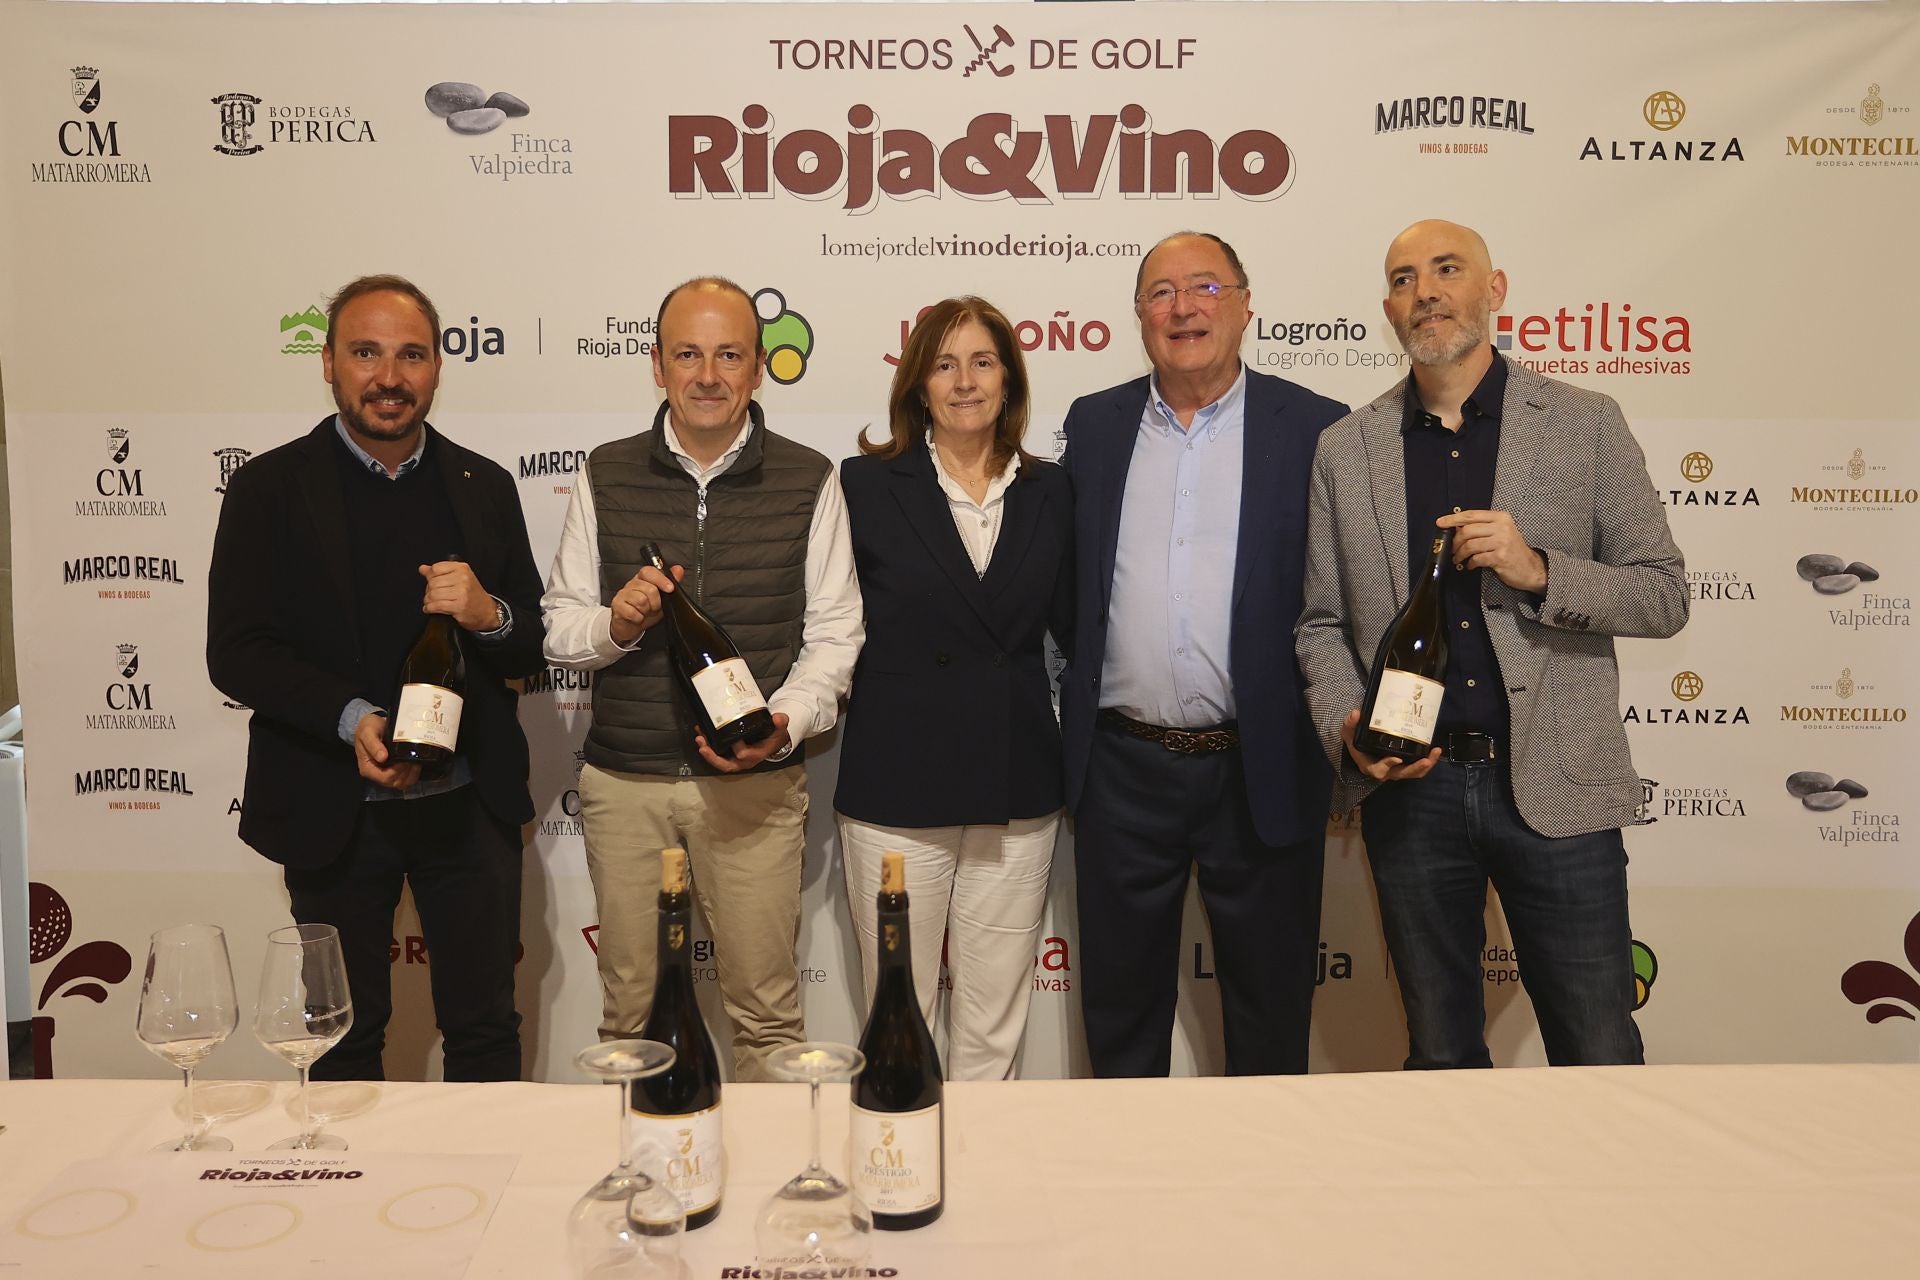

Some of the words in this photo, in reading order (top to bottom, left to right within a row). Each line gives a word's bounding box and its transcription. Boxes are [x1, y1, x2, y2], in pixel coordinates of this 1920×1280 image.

[769, 39, 953, 70] TORNEOS
[1030, 39, 1078, 69] DE
[1090, 38, 1197, 70] GOLF
[269, 106, 352, 118] BODEGAS
[1375, 96, 1464, 135] MARCO
[1470, 96, 1534, 135] REAL
[58, 121, 121, 157] CM
[269, 120, 377, 143] PERICA
[511, 134, 572, 153] Finca
[1419, 143, 1443, 154] VINOS
[1445, 144, 1451, 154] &
[1454, 143, 1488, 154] BODEGAS
[1579, 137, 1744, 161] ALTANZA
[1786, 136, 1919, 156] MONTECIL
[469, 154, 572, 181] Valpiedra
[668, 103, 1296, 216] Rioja&Vino
[1815, 160, 1855, 168] BODEGA
[32, 163, 151, 183] MATARROMERA
[821, 234, 1142, 264] lomejordelvinoderioja.com
[607, 317, 659, 334] Funda
[1257, 318, 1367, 345] Logroño
[1518, 302, 1691, 352] etilisa
[442, 316, 504, 363] oja
[578, 338, 621, 358] Rioja
[1256, 349, 1339, 369] Logroño
[1345, 349, 1410, 369] Depor
[1596, 356, 1691, 374] adhesivas
[519, 450, 586, 480] MARCO
[96, 469, 144, 496] CM
[554, 486, 571, 494] VINOS
[1657, 488, 1760, 506] TANZA
[1790, 487, 1918, 503] MONTECILLO
[76, 501, 167, 516] MATARROMERA
[63, 555, 130, 585] MARCO
[134, 556, 184, 585] REAL
[1684, 571, 1738, 581] ODEGAS
[98, 591, 116, 599] VINOS
[124, 591, 151, 599] BODEGAS
[1687, 582, 1756, 600] ERICA
[1862, 594, 1911, 610] Finca
[1828, 610, 1911, 631] Valpiedra
[106, 683, 153, 710] CM
[557, 702, 575, 711] VINOS
[1623, 705, 1750, 724] ALTANZA
[1780, 706, 1906, 722] MONTECILLO
[86, 714, 176, 729] MATARROMERA
[75, 767, 140, 796] MARCO
[144, 767, 193, 796] REAL
[1664, 788, 1728, 797] BODEGAS
[109, 802, 126, 810] VINOS
[134, 802, 160, 810] BODEGAS
[1663, 799, 1747, 816] PERICA
[1852, 811, 1900, 826] Finca
[1818, 827, 1900, 847] Valpiedra
[667, 1156, 701, 1179] CM
[870, 1148, 904, 1168] CM
[198, 1168, 363, 1182] Rioja&Vino
[864, 1166, 912, 1177] PRESTIGIO
